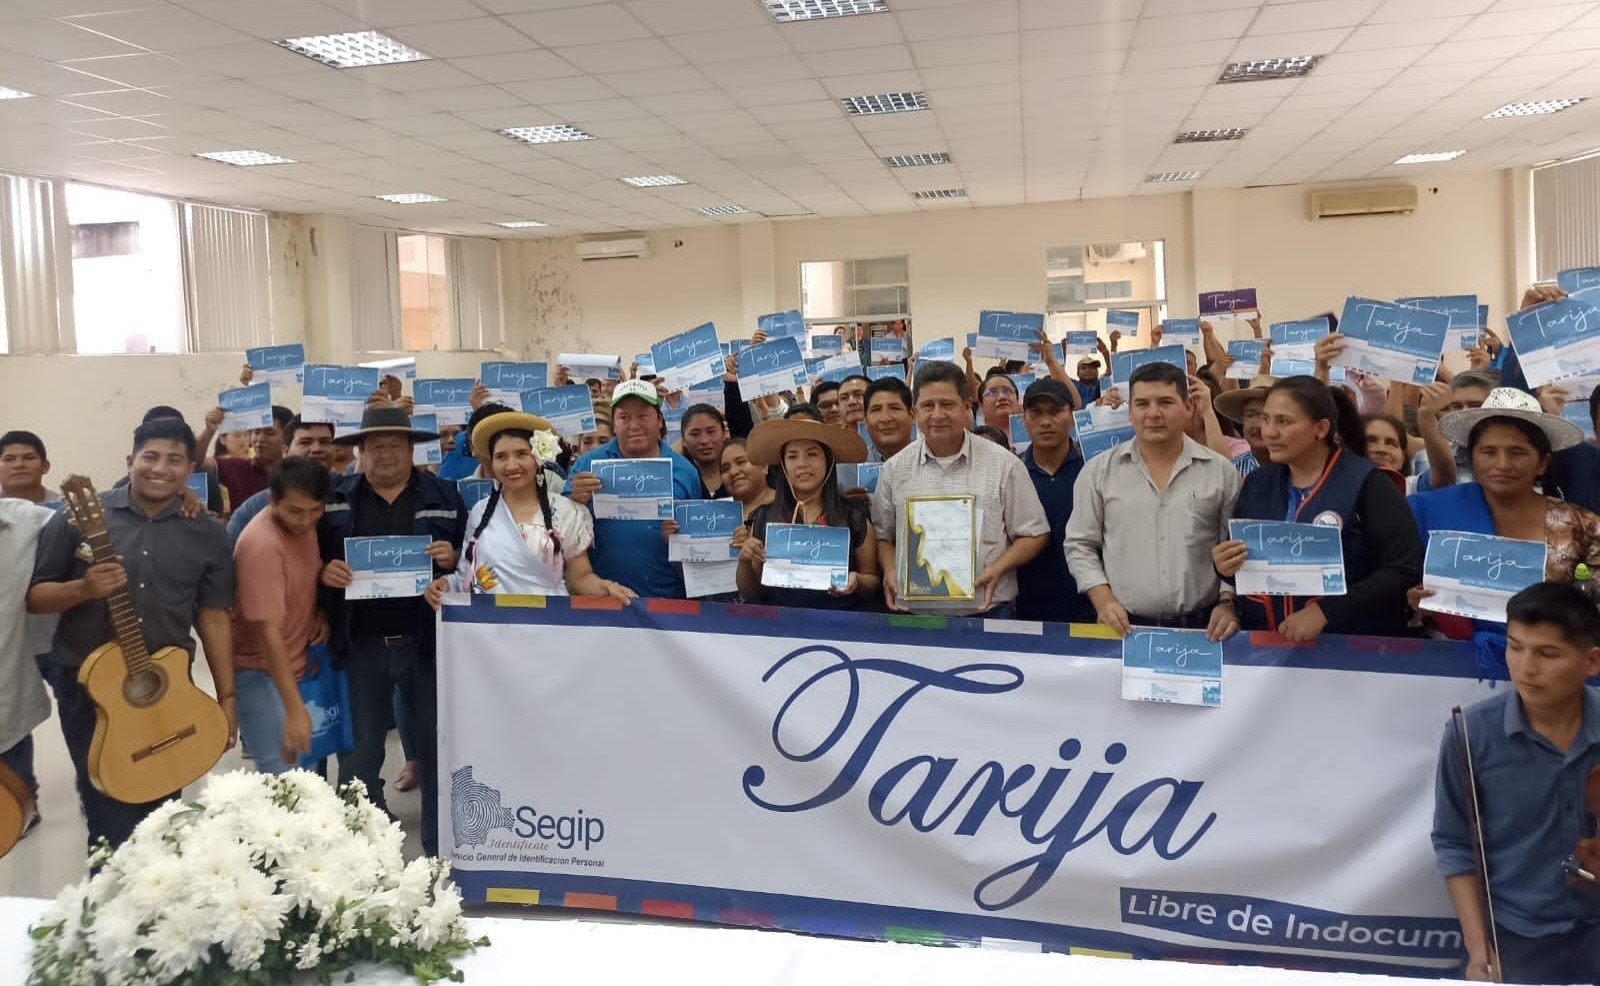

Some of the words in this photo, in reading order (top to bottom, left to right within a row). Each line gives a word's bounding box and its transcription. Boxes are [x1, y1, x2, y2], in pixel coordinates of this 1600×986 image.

[984, 314, 1036, 338] Tarija
[1355, 302, 1437, 344] Tarija
[253, 350, 300, 366] Tarija
[657, 337, 711, 361] Tarija
[741, 344, 793, 368] Tarija
[311, 367, 372, 393] Tarija
[488, 363, 543, 386] Tarija
[419, 380, 471, 400] Tarija
[528, 390, 584, 411] Tarija
[600, 463, 664, 492] Tarija
[676, 502, 736, 531] Tarija
[355, 539, 422, 565] Tarija
[777, 527, 841, 558] Tarija
[1242, 523, 1329, 556] Tarija
[1441, 537, 1535, 580] Tarija
[1134, 631, 1214, 667] Tarija
[742, 644, 1217, 911] Tarija
[515, 805, 604, 851] Segip
[476, 852, 507, 862] General
[508, 853, 518, 862] de
[571, 857, 605, 867] Personal
[1128, 893, 1217, 926] Libre
[1227, 904, 1273, 937] de
[1284, 913, 1462, 949] Indocum
